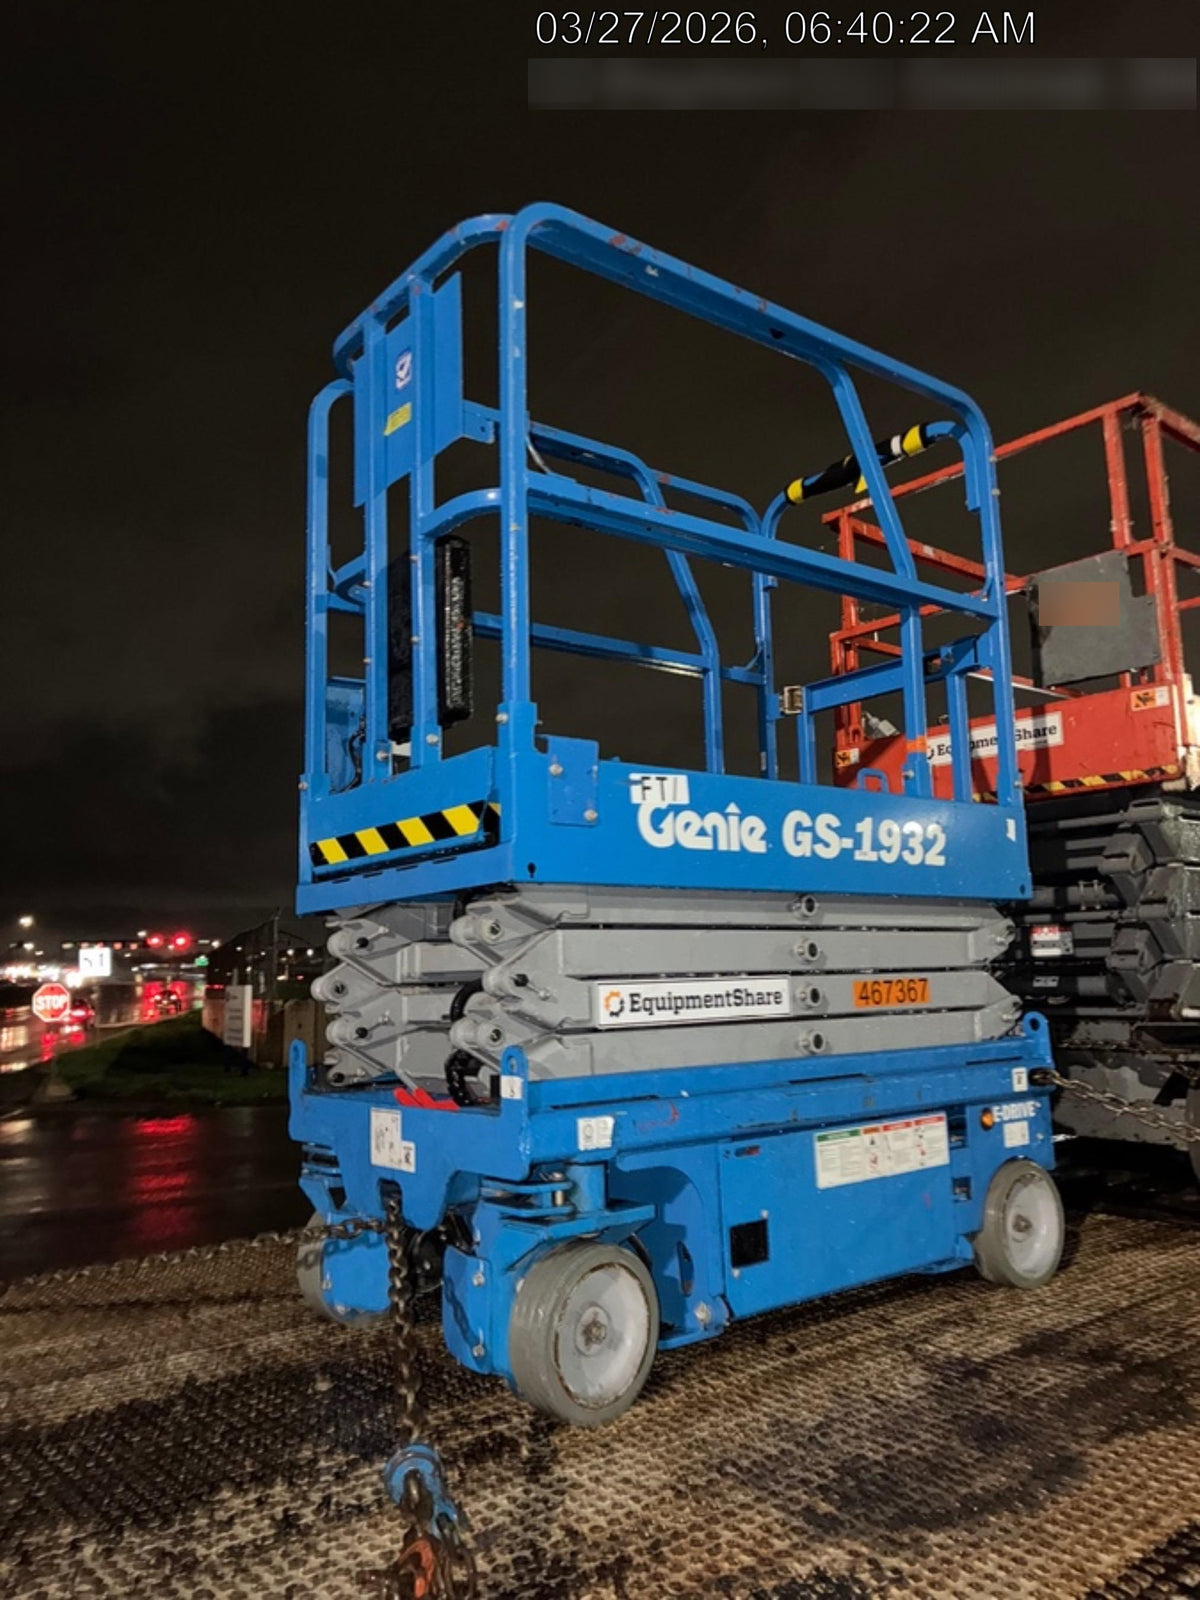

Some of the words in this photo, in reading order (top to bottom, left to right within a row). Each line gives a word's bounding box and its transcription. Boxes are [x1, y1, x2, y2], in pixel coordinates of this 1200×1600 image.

[637, 802, 768, 853] Genie
[782, 810, 949, 867] GS-1932
[36, 995, 67, 1010] STOP
[628, 987, 783, 1015] EquipmentShare
[859, 978, 928, 1005] 467367
